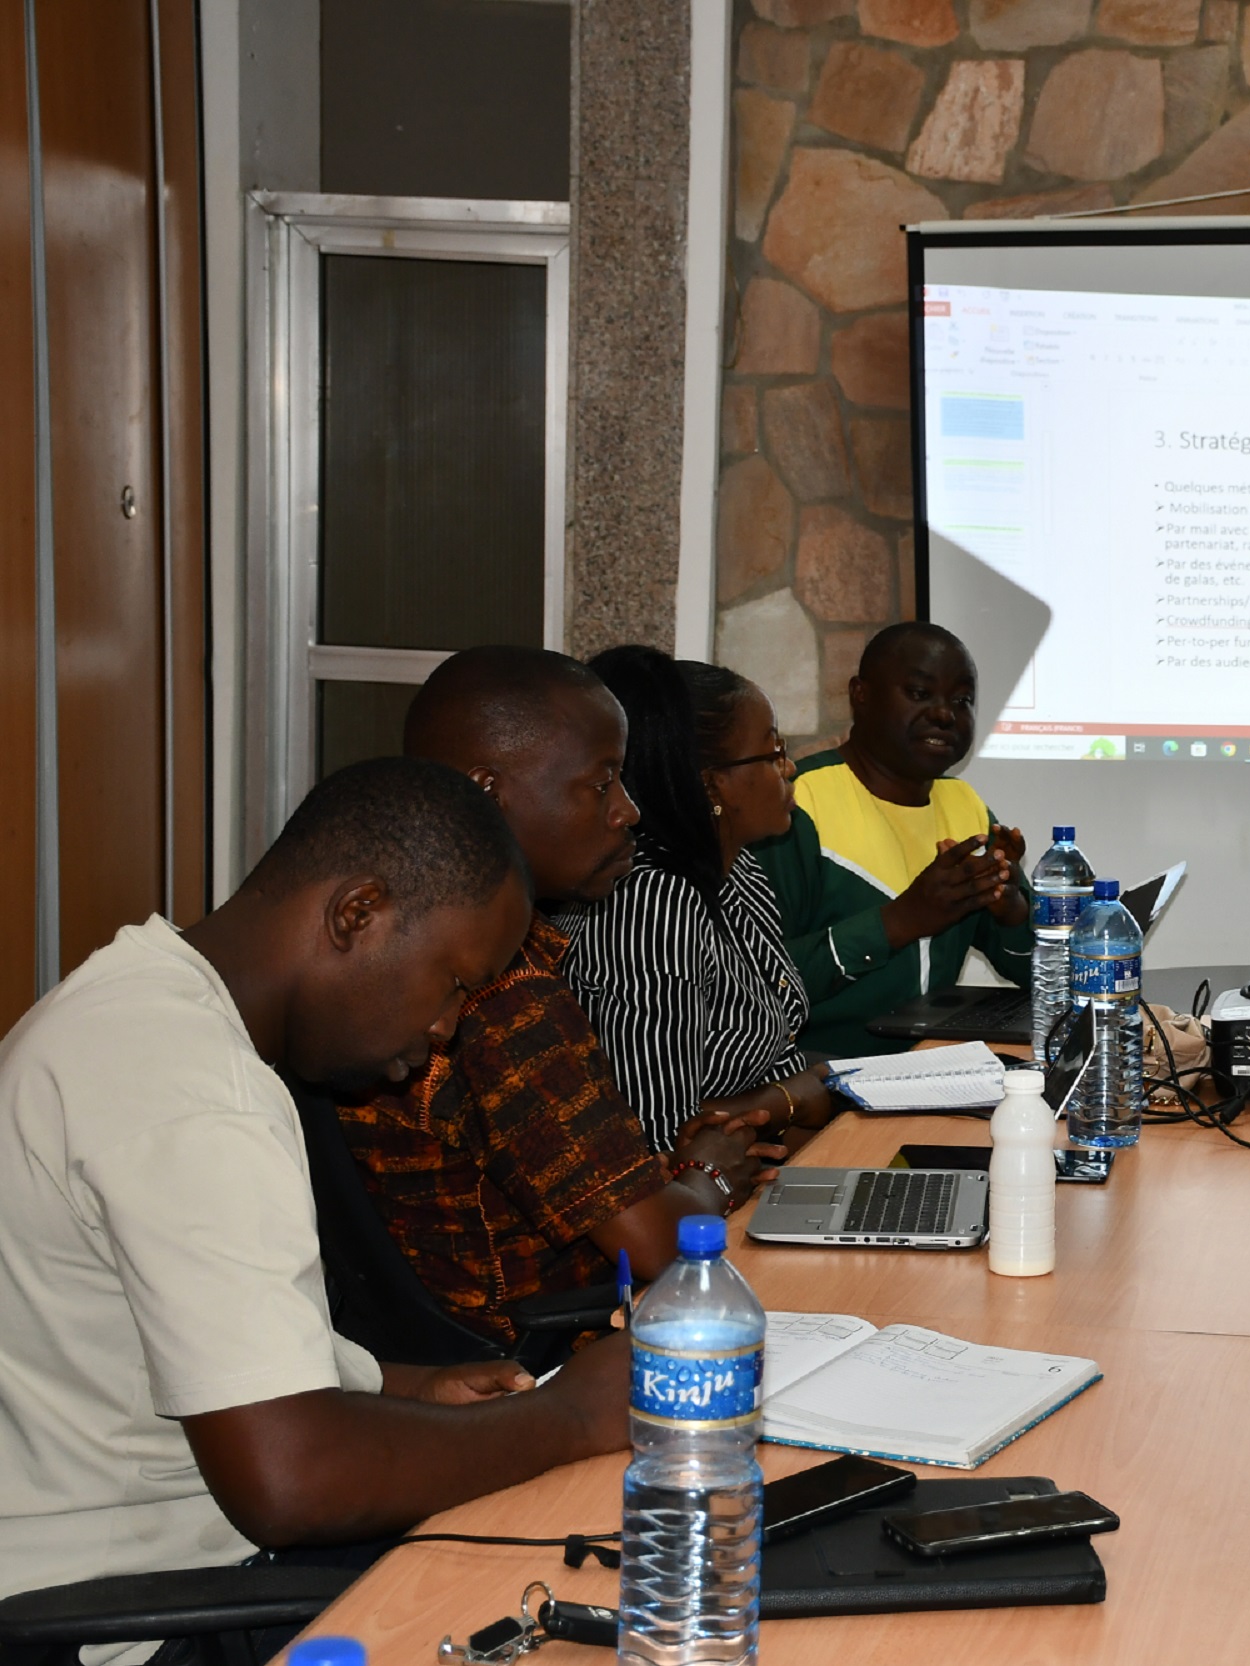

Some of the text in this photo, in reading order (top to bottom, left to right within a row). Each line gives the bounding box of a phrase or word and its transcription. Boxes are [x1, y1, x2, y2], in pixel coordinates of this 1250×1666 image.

[1154, 431, 1172, 449] 3.
[1164, 482, 1224, 497] Quelques
[1170, 503, 1247, 516] Mobilisation
[1166, 523, 1187, 535] Par
[1190, 523, 1216, 535] mail
[1221, 526, 1249, 536] avec
[1165, 539, 1238, 553] partenariat,
[1166, 558, 1187, 570] Par
[1190, 559, 1212, 570] des
[1165, 573, 1180, 585] de
[1184, 574, 1219, 588] galas,
[1166, 636, 1230, 650] Per-to-per
[1166, 656, 1187, 668] Par
[1190, 656, 1212, 668] des
[643, 1369, 735, 1407] Kinju
